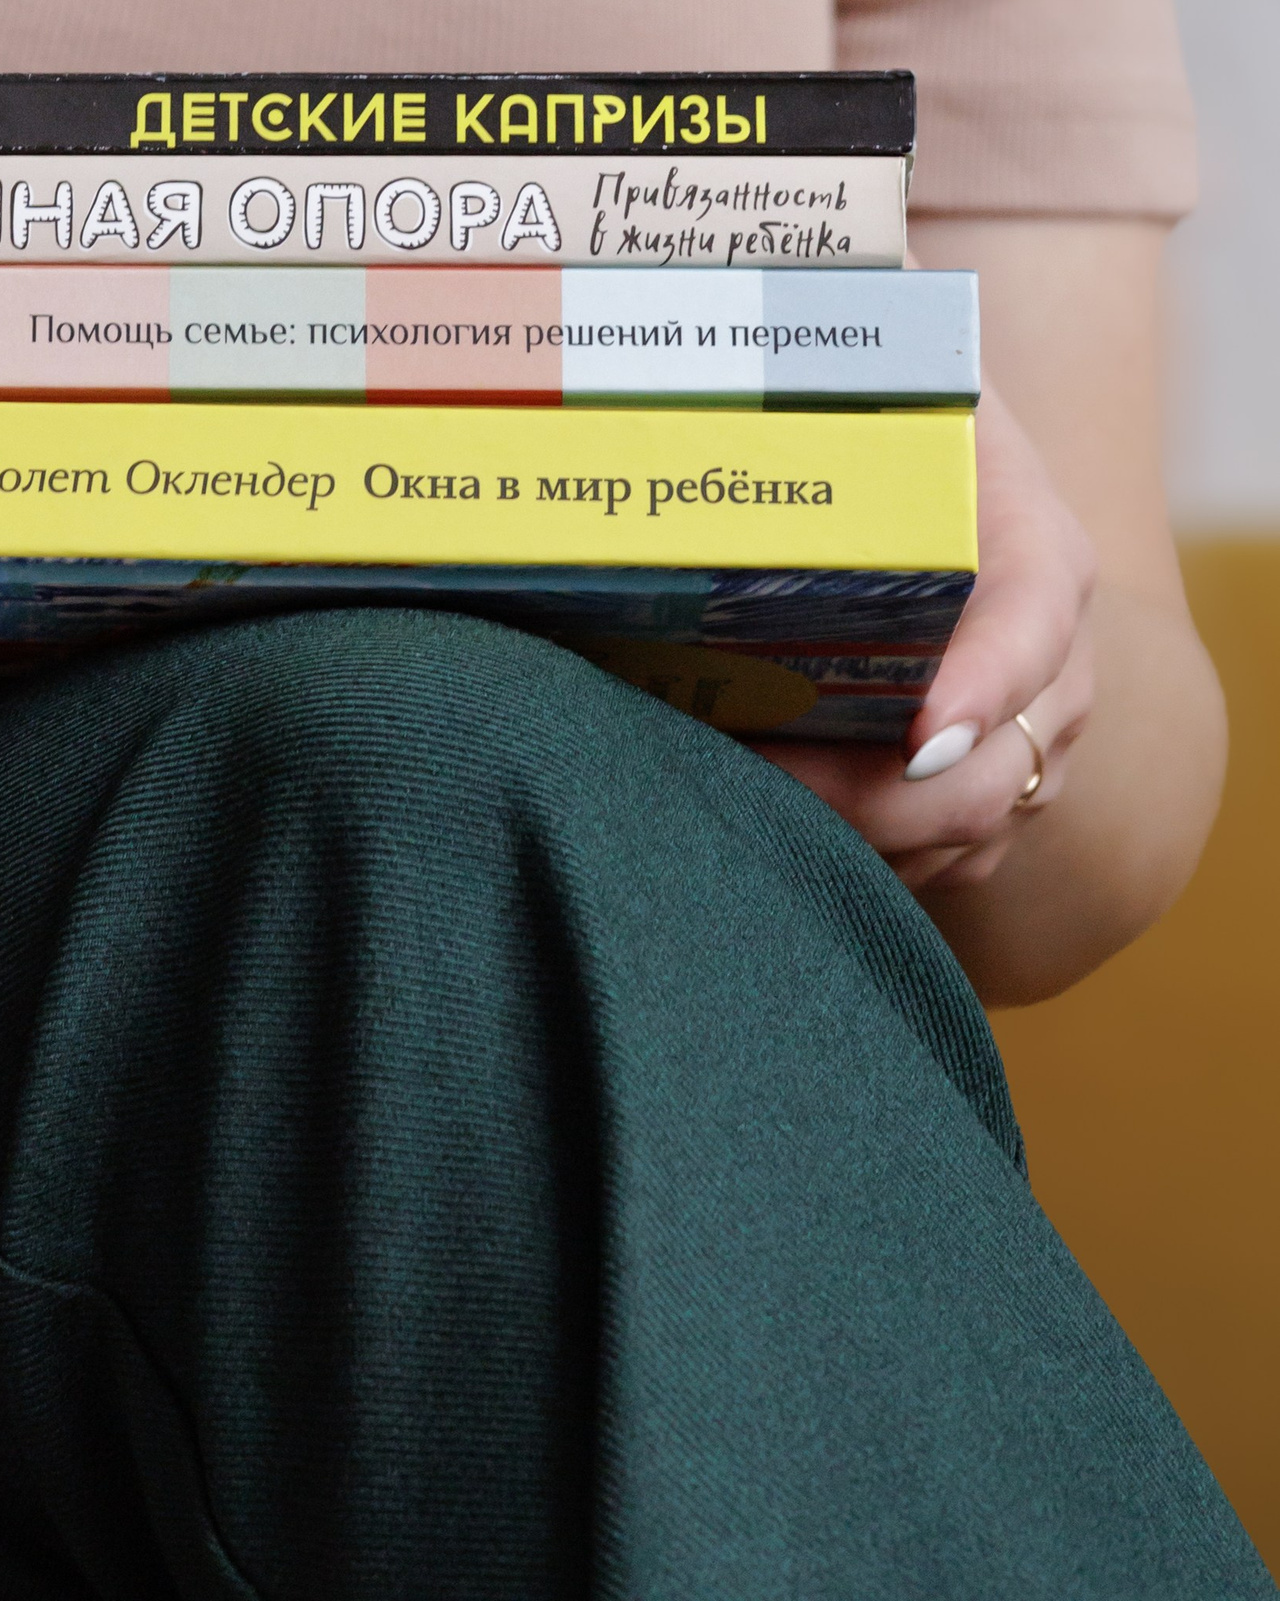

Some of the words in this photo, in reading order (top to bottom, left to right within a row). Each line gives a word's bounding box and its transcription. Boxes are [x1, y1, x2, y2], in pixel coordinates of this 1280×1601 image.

[130, 92, 427, 148] ДЕТСКИЕ
[456, 93, 767, 144] КАПРИЗЫ
[228, 176, 562, 251] ОПОРА
[593, 167, 847, 220] Привязанность
[590, 210, 607, 256] в
[616, 225, 715, 267] жизни
[727, 221, 851, 266] ребёнка
[29, 314, 172, 350] Помощь
[184, 321, 296, 346] семье:
[308, 321, 511, 348] психология
[524, 320, 682, 354] решений
[696, 324, 717, 348] и
[730, 324, 883, 355] перемен
[125, 459, 336, 512] Оклендер
[363, 463, 482, 501] Окна
[496, 475, 520, 502] в
[535, 475, 631, 516] мир
[646, 467, 834, 517] ребёнка
